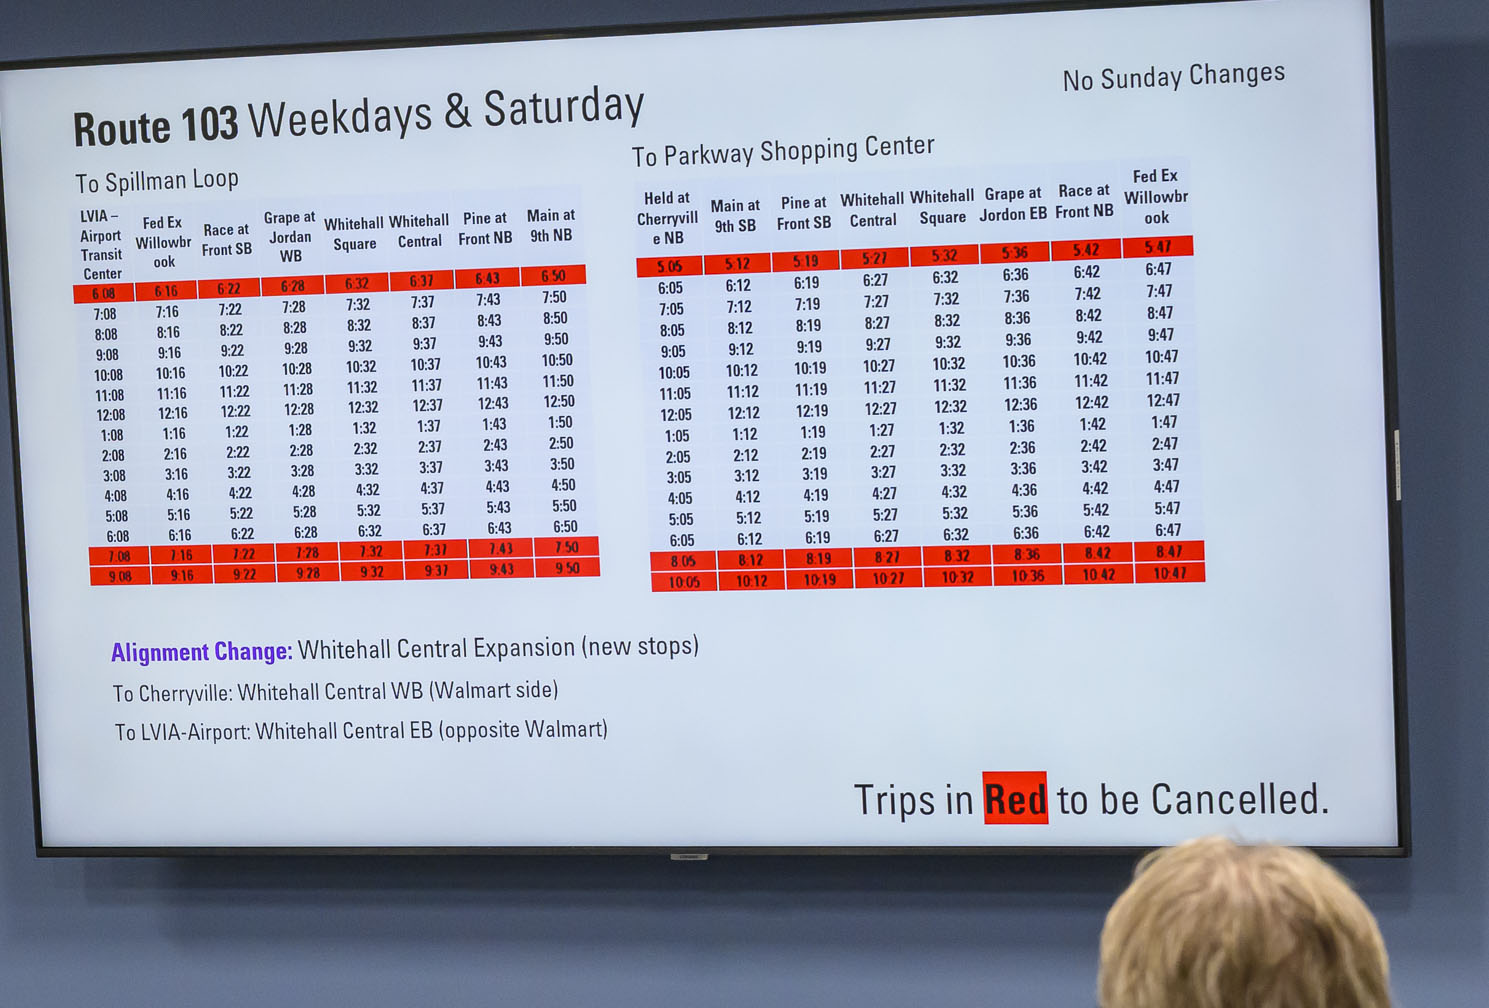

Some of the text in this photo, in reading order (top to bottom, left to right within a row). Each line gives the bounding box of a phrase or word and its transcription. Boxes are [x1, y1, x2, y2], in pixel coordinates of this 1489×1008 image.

[1064, 63, 1285, 92] No Sunday Changes
[74, 85, 644, 147] Route 103 Weekdays & Saturday
[632, 135, 935, 168] To Parkway Shopping Center
[75, 168, 238, 197] To Spillman Loop
[1133, 168, 1178, 184] Fed Ex
[645, 191, 690, 205] Held at
[909, 188, 974, 204] Whitehall
[985, 187, 1042, 203] Grape at
[1059, 184, 1110, 198] Race at
[1124, 189, 1189, 205] Willowbr
[711, 199, 760, 213] Main at
[781, 196, 827, 210] Pine at
[840, 191, 904, 207] Whitehall
[80, 209, 108, 223] LVIA
[264, 211, 316, 226] Grape at
[463, 212, 507, 225] Pine at
[527, 209, 575, 222] Main at
[637, 210, 698, 227] Cherryvill
[979, 206, 1047, 222] Jordon EB
[1055, 203, 1114, 219] Front NB
[1144, 210, 1170, 224] ook
[143, 216, 182, 230] Fed Ex
[324, 216, 384, 231] Whitehall
[388, 213, 449, 228] Whitehall
[715, 218, 756, 233] 9th SB
[777, 215, 831, 231] Front SB
[850, 212, 897, 227] Central
[920, 211, 966, 227] Square
[80, 229, 122, 245] Airport
[204, 224, 249, 237] Race at
[269, 230, 311, 244] Jordan
[458, 230, 512, 246] Front NB
[530, 228, 573, 243] 9th NB
[653, 231, 684, 245] e NB
[135, 235, 192, 250] Willowbr
[334, 238, 377, 253] Square
[398, 233, 442, 248] Central
[80, 249, 123, 262] Transit
[202, 242, 252, 256] Front SB
[280, 249, 302, 263] WB
[154, 255, 176, 268] ook
[84, 268, 122, 280] Center
[658, 262, 1172, 295] 6:05 6:12 6:19 6:27 6:32 6:36 6:42 6:47
[93, 290, 567, 321] 7:08 7:16 7:22 7:28 7:32 7:37 7:43 7:50
[659, 349, 1179, 380] 10:05 10:12 10:19 10:27 10:32 10:36 10:42 10:47
[97, 394, 575, 421] 12:08 12:16 12:22 12:28 12:32 12:37 12:43 12:50
[107, 520, 578, 543] 6:08 6:16 6:22 6:28 6:32 6:37 6:43 6:50
[670, 523, 1181, 547] 6:05 6:12 6:19 6:27 6:32 6:36 6:42 6:47
[111, 633, 699, 666] Alignment Change: Whitehall Central Expansion (new stops)
[113, 679, 558, 706] To Cherryville: Whitehall Central WB (Walmart side)
[115, 718, 607, 744] To LVIA-Airport: Whitehall Central EB (opposite Walmart)
[854, 782, 1328, 823] Trips in Red to be Cancelled.
